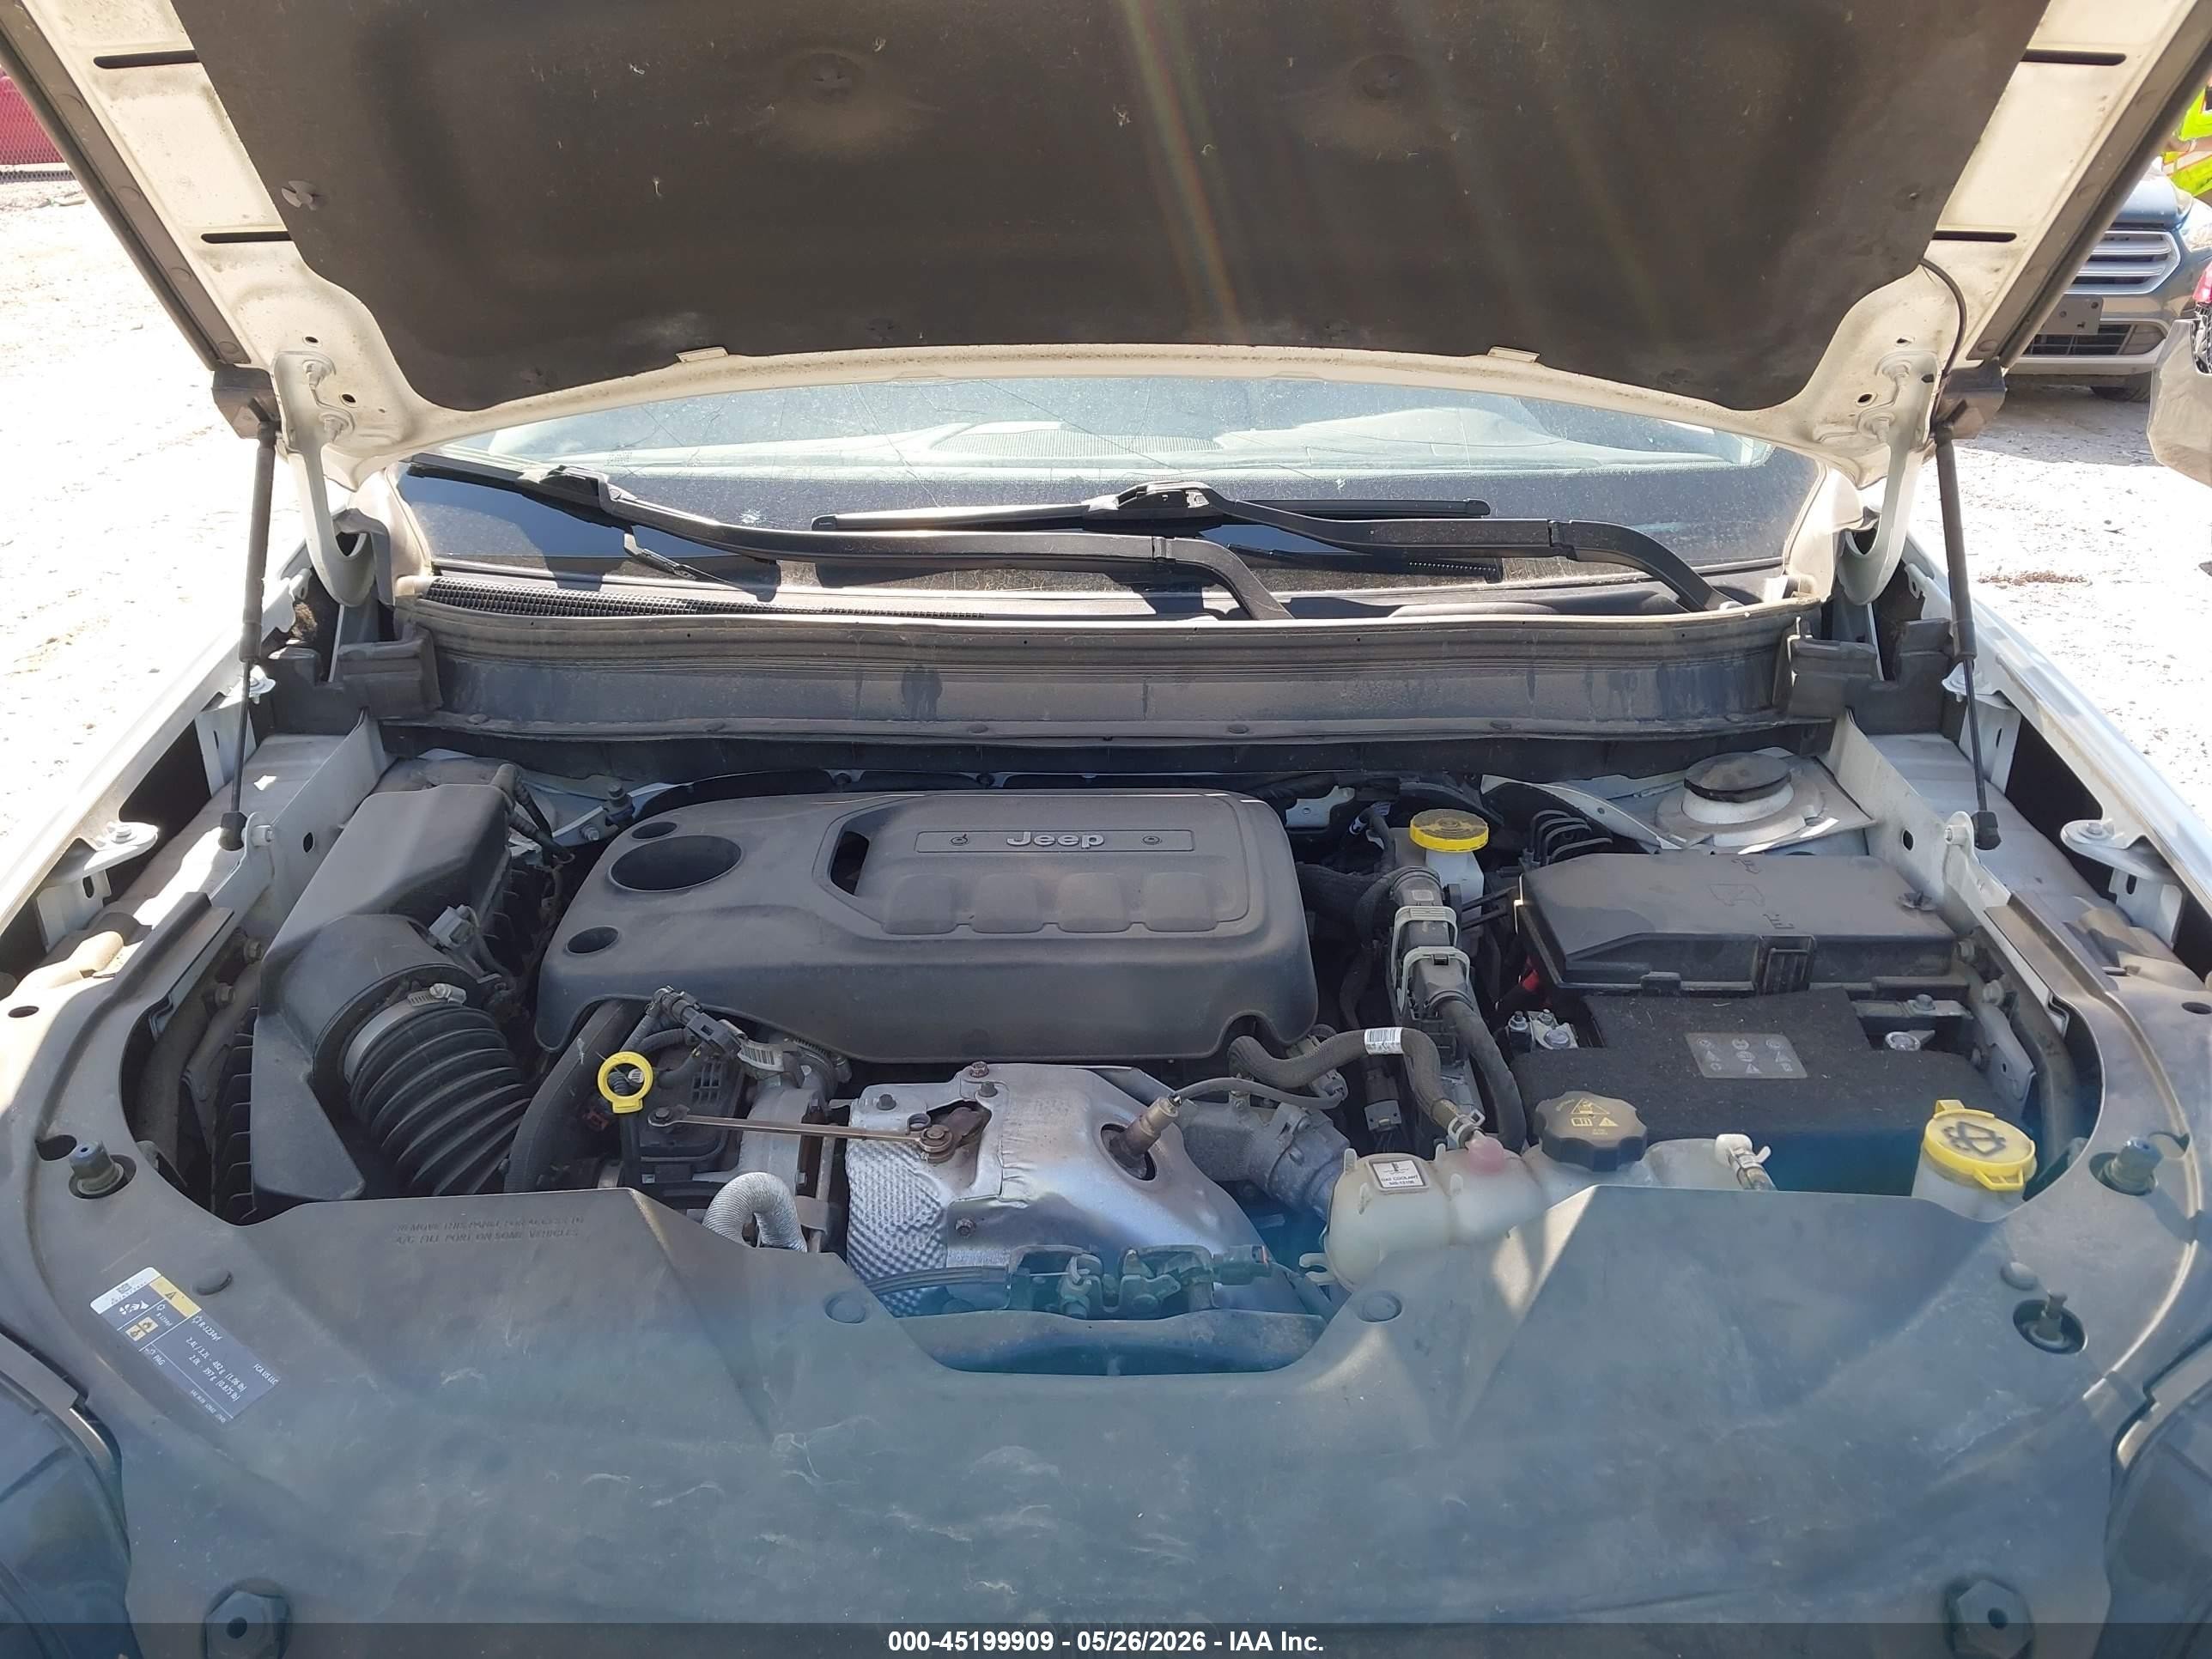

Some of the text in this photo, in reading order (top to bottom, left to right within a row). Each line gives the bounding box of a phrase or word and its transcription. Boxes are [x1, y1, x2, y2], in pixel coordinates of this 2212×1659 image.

[1007, 831, 1104, 848] Jeep
[445, 1234, 471, 1243] PORT
[153, 1355, 166, 1365] PAG
